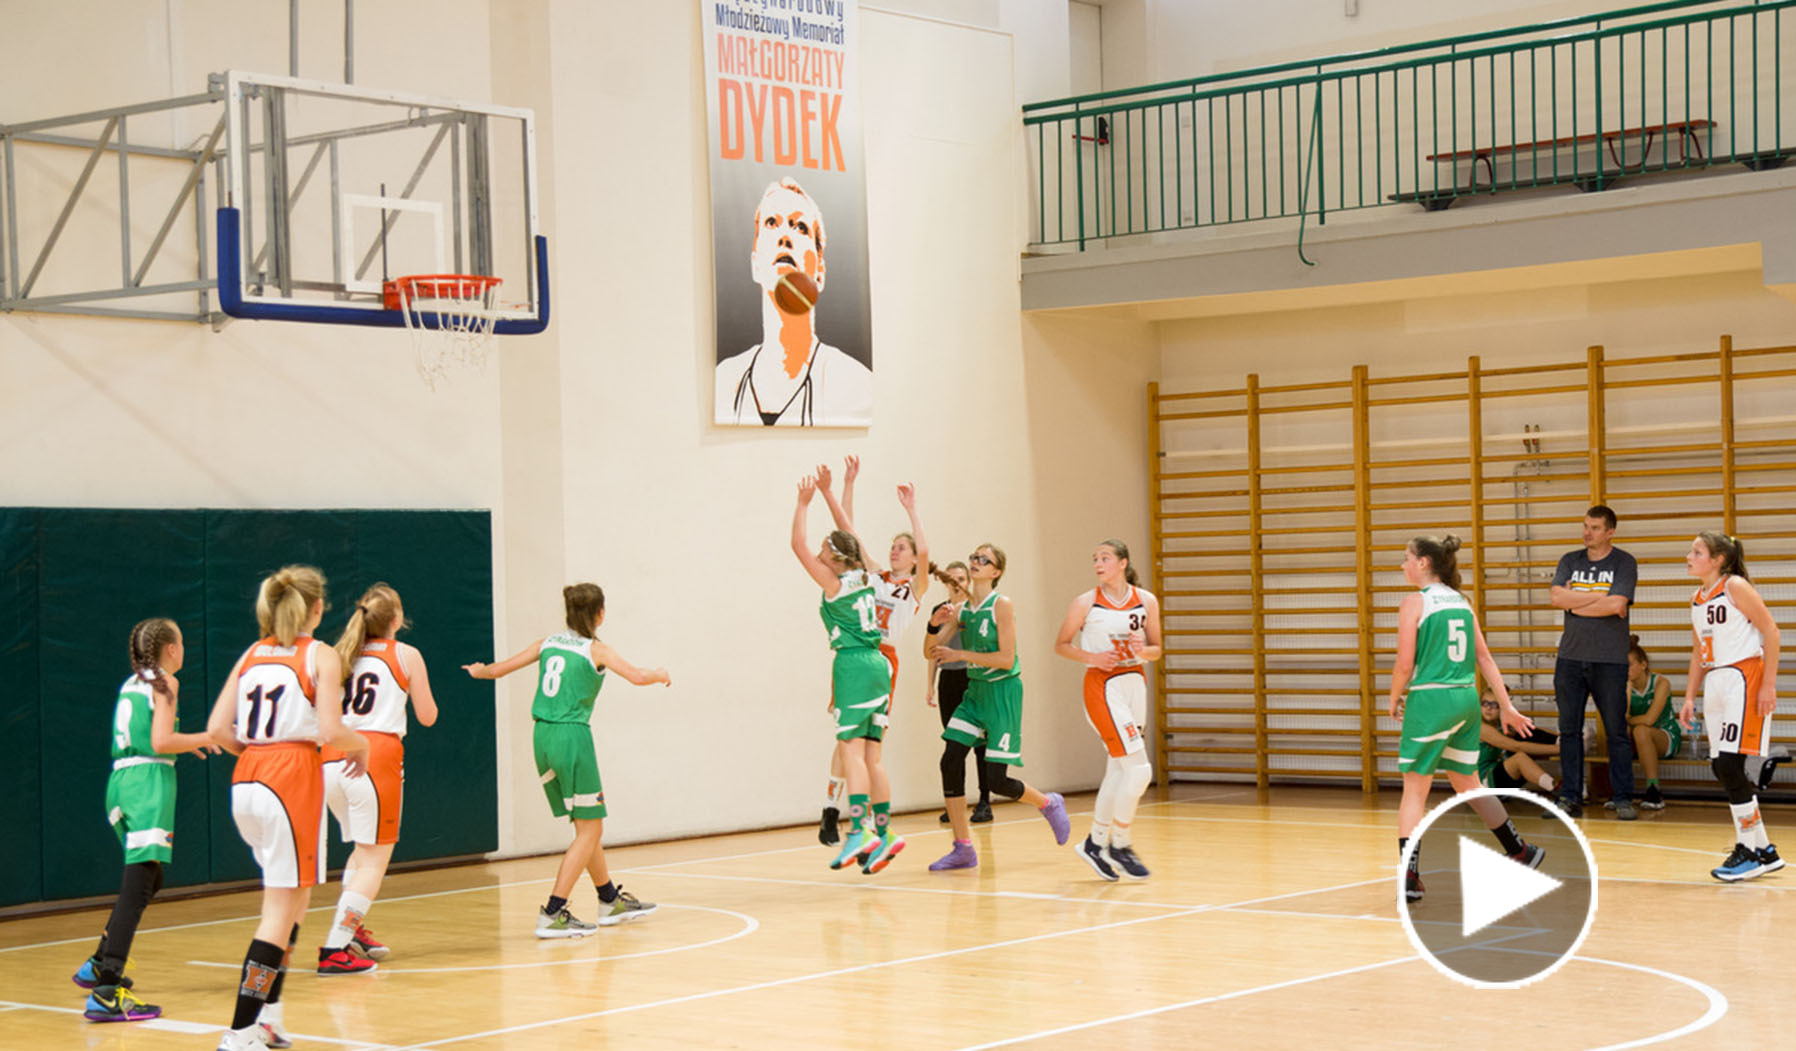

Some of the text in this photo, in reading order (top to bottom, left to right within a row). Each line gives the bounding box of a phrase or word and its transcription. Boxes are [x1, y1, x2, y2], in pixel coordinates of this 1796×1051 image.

[715, 3, 844, 45] Młodzieżowy Memoriał
[717, 32, 845, 90] MAŁGORZATY
[718, 77, 847, 173] DYDEK
[1571, 570, 1614, 584] ALL IN
[979, 618, 989, 637] 4
[1707, 604, 1727, 625] 50
[1447, 619, 1467, 662] 5
[542, 655, 566, 697] 8
[246, 684, 286, 739] 11
[998, 732, 1010, 752] 4
